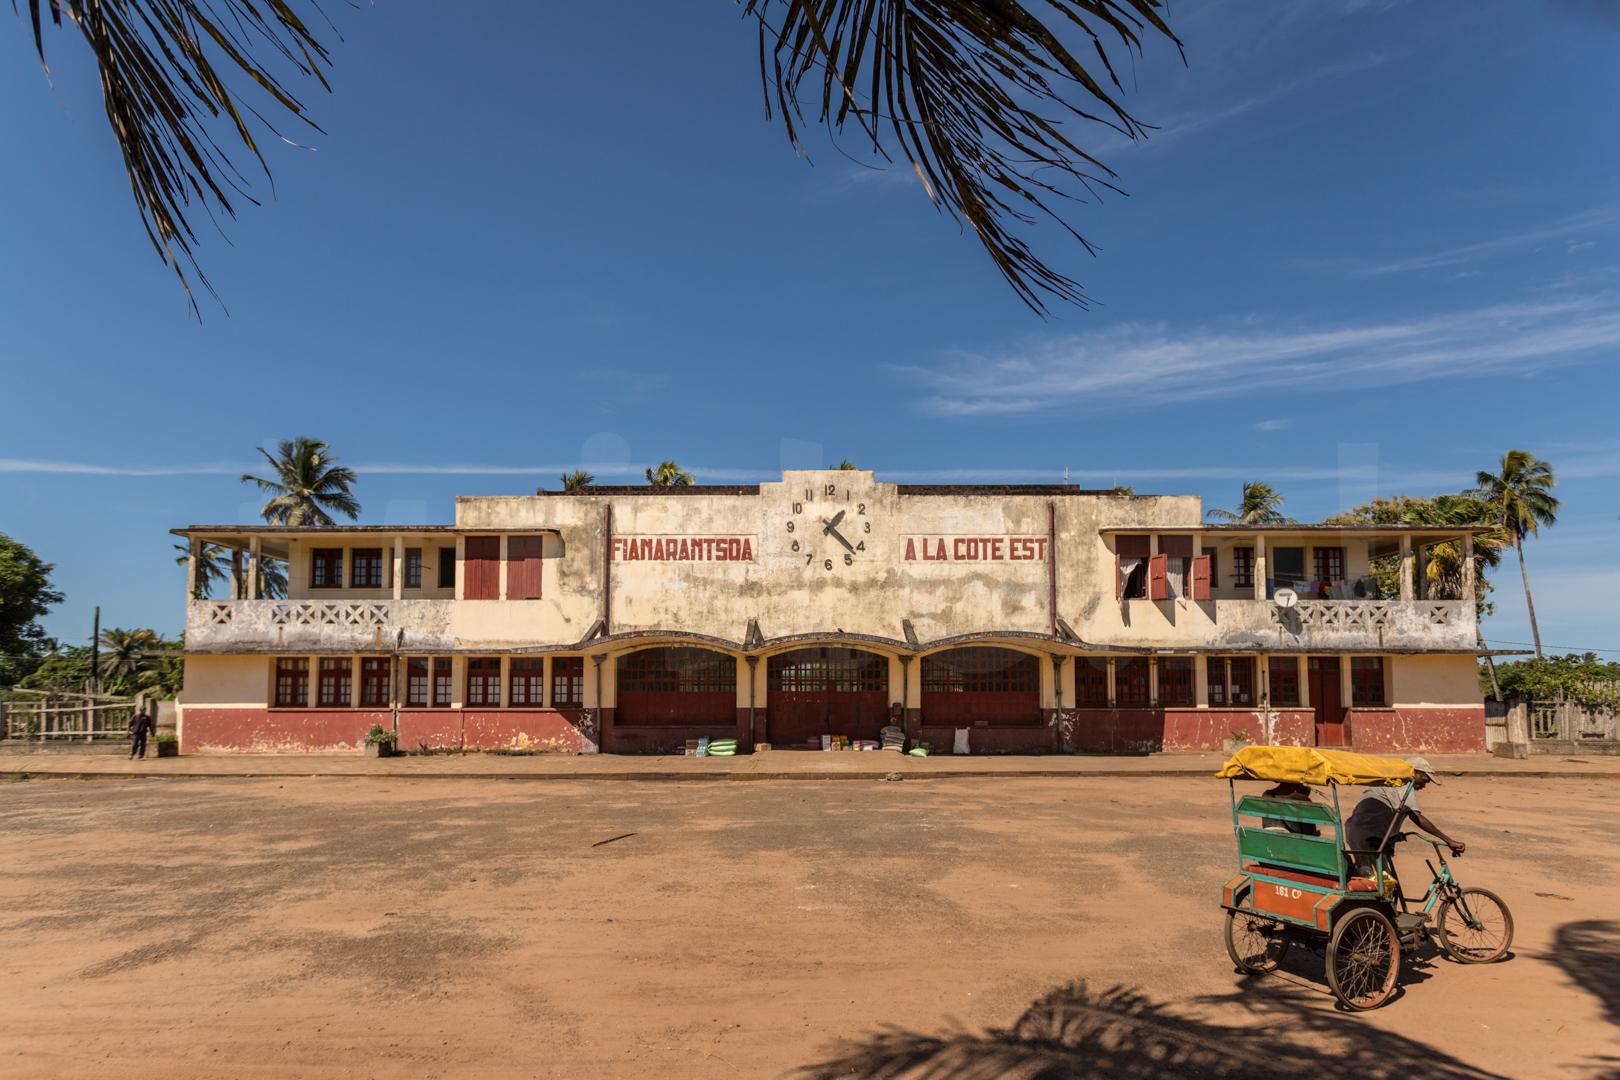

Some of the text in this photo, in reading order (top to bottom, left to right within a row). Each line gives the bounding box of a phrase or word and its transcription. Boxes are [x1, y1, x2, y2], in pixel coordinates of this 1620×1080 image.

[805, 488, 813, 501] 11
[824, 484, 836, 496] 12
[792, 502, 802, 515] 10
[858, 503, 866, 515] 2
[786, 521, 795, 533] 9
[863, 522, 871, 534] 3
[610, 537, 753, 561] FIANARANTSOA
[856, 540, 866, 552] 4
[904, 537, 1048, 561] A LA COTE EST
[805, 554, 813, 566] 7
[824, 559, 833, 571] 6
[843, 554, 853, 566] 5
